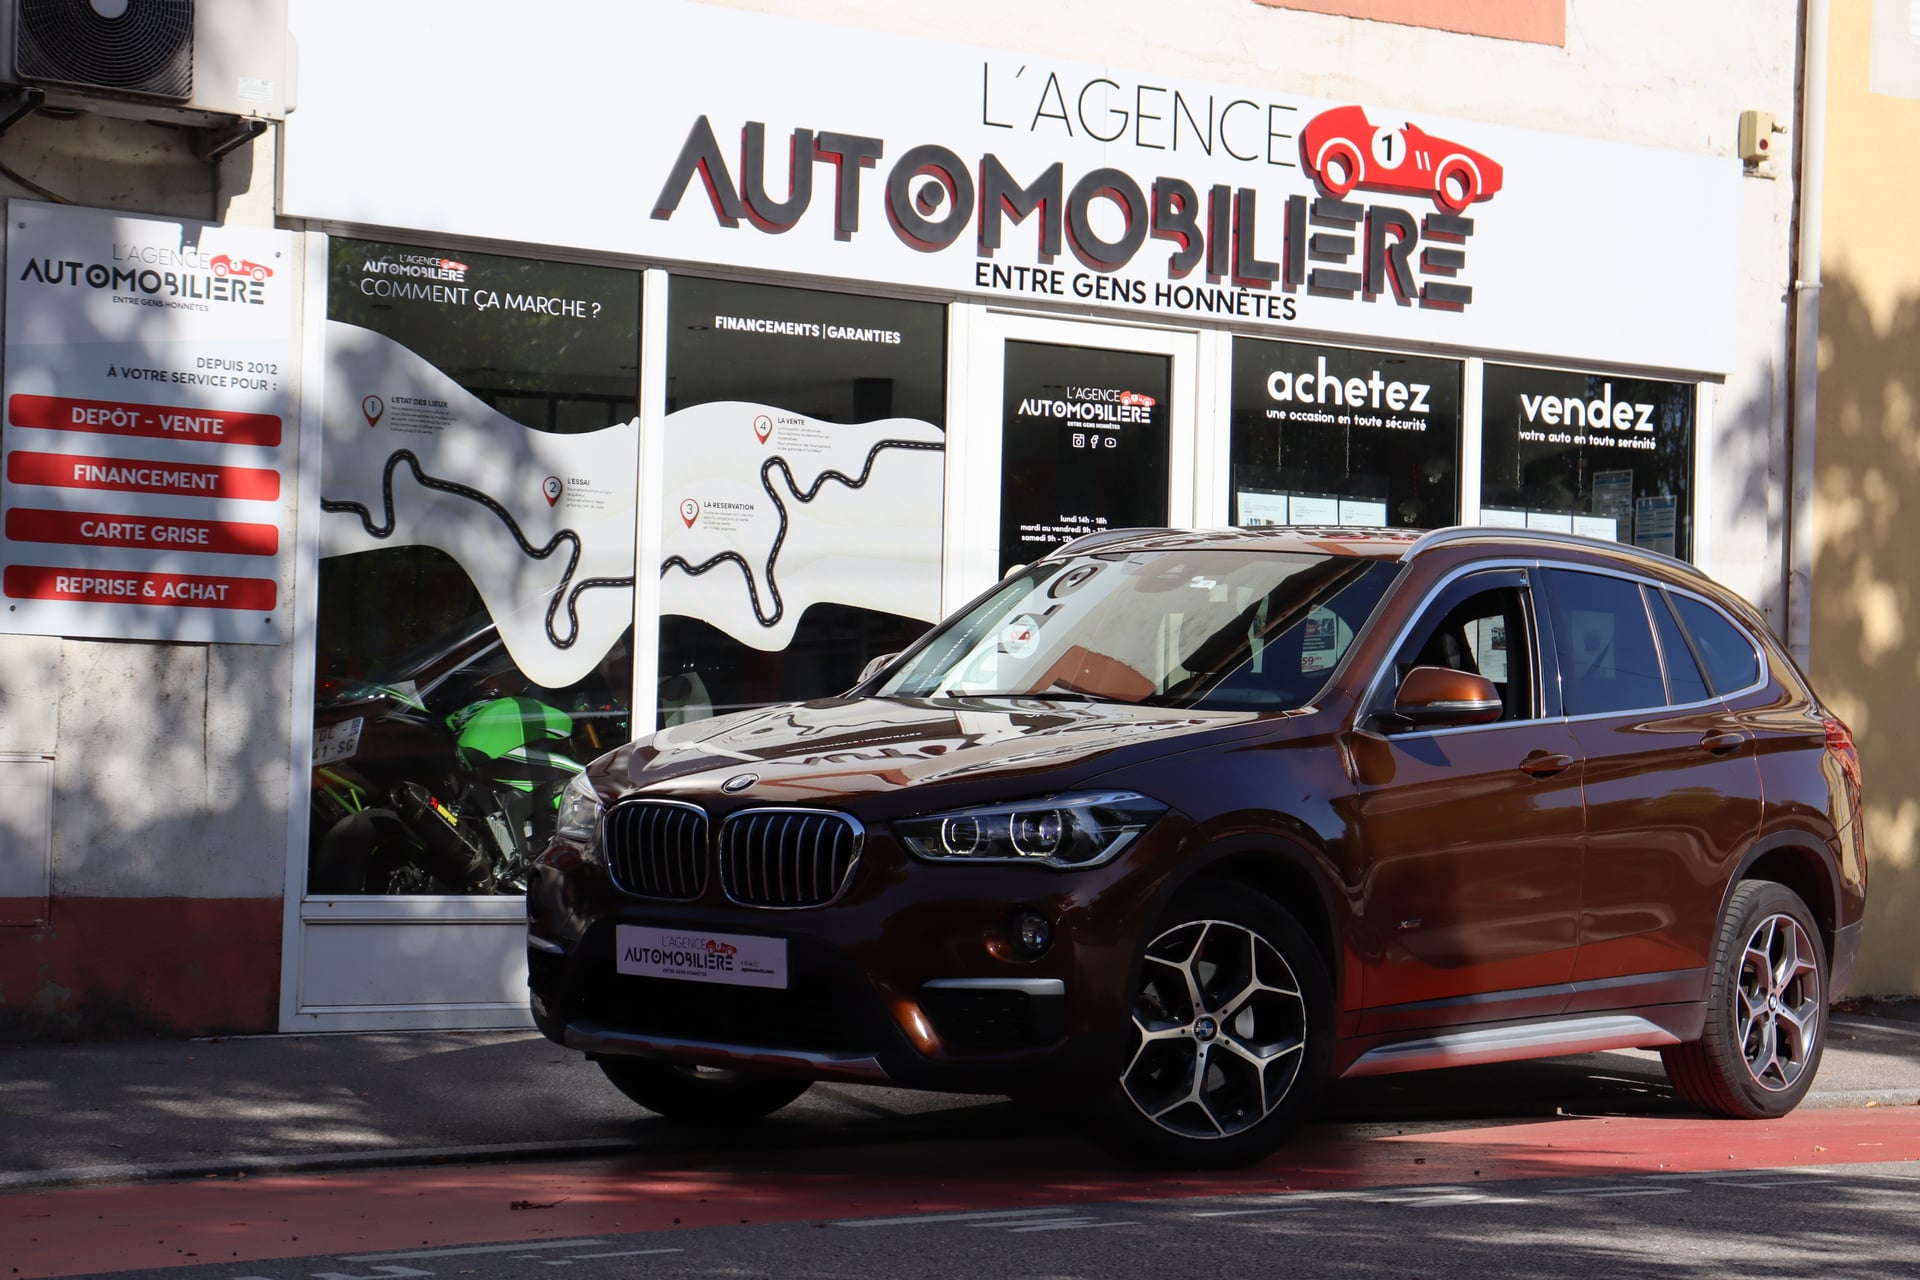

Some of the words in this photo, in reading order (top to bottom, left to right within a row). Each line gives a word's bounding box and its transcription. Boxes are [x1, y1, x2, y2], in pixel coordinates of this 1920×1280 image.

[983, 62, 1298, 167] L'AGENCE
[1380, 134, 1392, 161] 1
[113, 243, 209, 270] L'AGENCE
[400, 254, 441, 266] L'AGENCE
[360, 278, 469, 306] COMMENT
[473, 290, 500, 312] ÇA
[504, 293, 586, 318] MARCHE
[592, 302, 601, 318] ?
[976, 262, 1065, 295] ENTRE
[1073, 273, 1147, 304] GENS
[1155, 283, 1297, 321] HONNÊTES
[113, 296, 139, 305] ENTRE
[141, 299, 164, 308] GENS
[715, 315, 820, 337] FINANCEMENTS
[197, 357, 243, 372] DEPUIS
[248, 362, 278, 375] 2012
[107, 364, 117, 378] À
[121, 367, 167, 382] VOTRE
[171, 372, 227, 387] SERVICE
[231, 378, 268, 391] POUR
[1267, 356, 1431, 413] achetez
[413, 398, 427, 406] DES
[428, 400, 449, 408] LIEUX
[1066, 386, 1120, 402] L'AGENCE
[1520, 382, 1654, 432] vendez
[72, 407, 140, 428] DEPÔT
[159, 414, 224, 435] VENTE
[760, 421, 766, 430] 4
[786, 418, 806, 426] VENTE
[1266, 409, 1286, 420] une
[1289, 410, 1335, 424] occasion
[1338, 415, 1350, 425] en
[1354, 414, 1382, 428] toute
[1385, 416, 1427, 432] sécurité
[1519, 430, 1545, 441] votre
[1548, 432, 1571, 443] auto
[1574, 435, 1586, 445] en
[1589, 434, 1615, 446] toute
[73, 464, 219, 490] FINANCEMENT
[549, 481, 557, 493] 2
[686, 504, 693, 515] 3
[1060, 515, 1077, 523] lundi
[80, 521, 146, 541] CARTE
[151, 525, 209, 544] GRISE
[1021, 534, 1046, 542] samedi
[1052, 525, 1081, 533] vendredi
[55, 576, 138, 597] REPRISE
[142, 581, 156, 597] &
[161, 582, 229, 601] ACHAT
[662, 935, 707, 950] L'AGENCE
